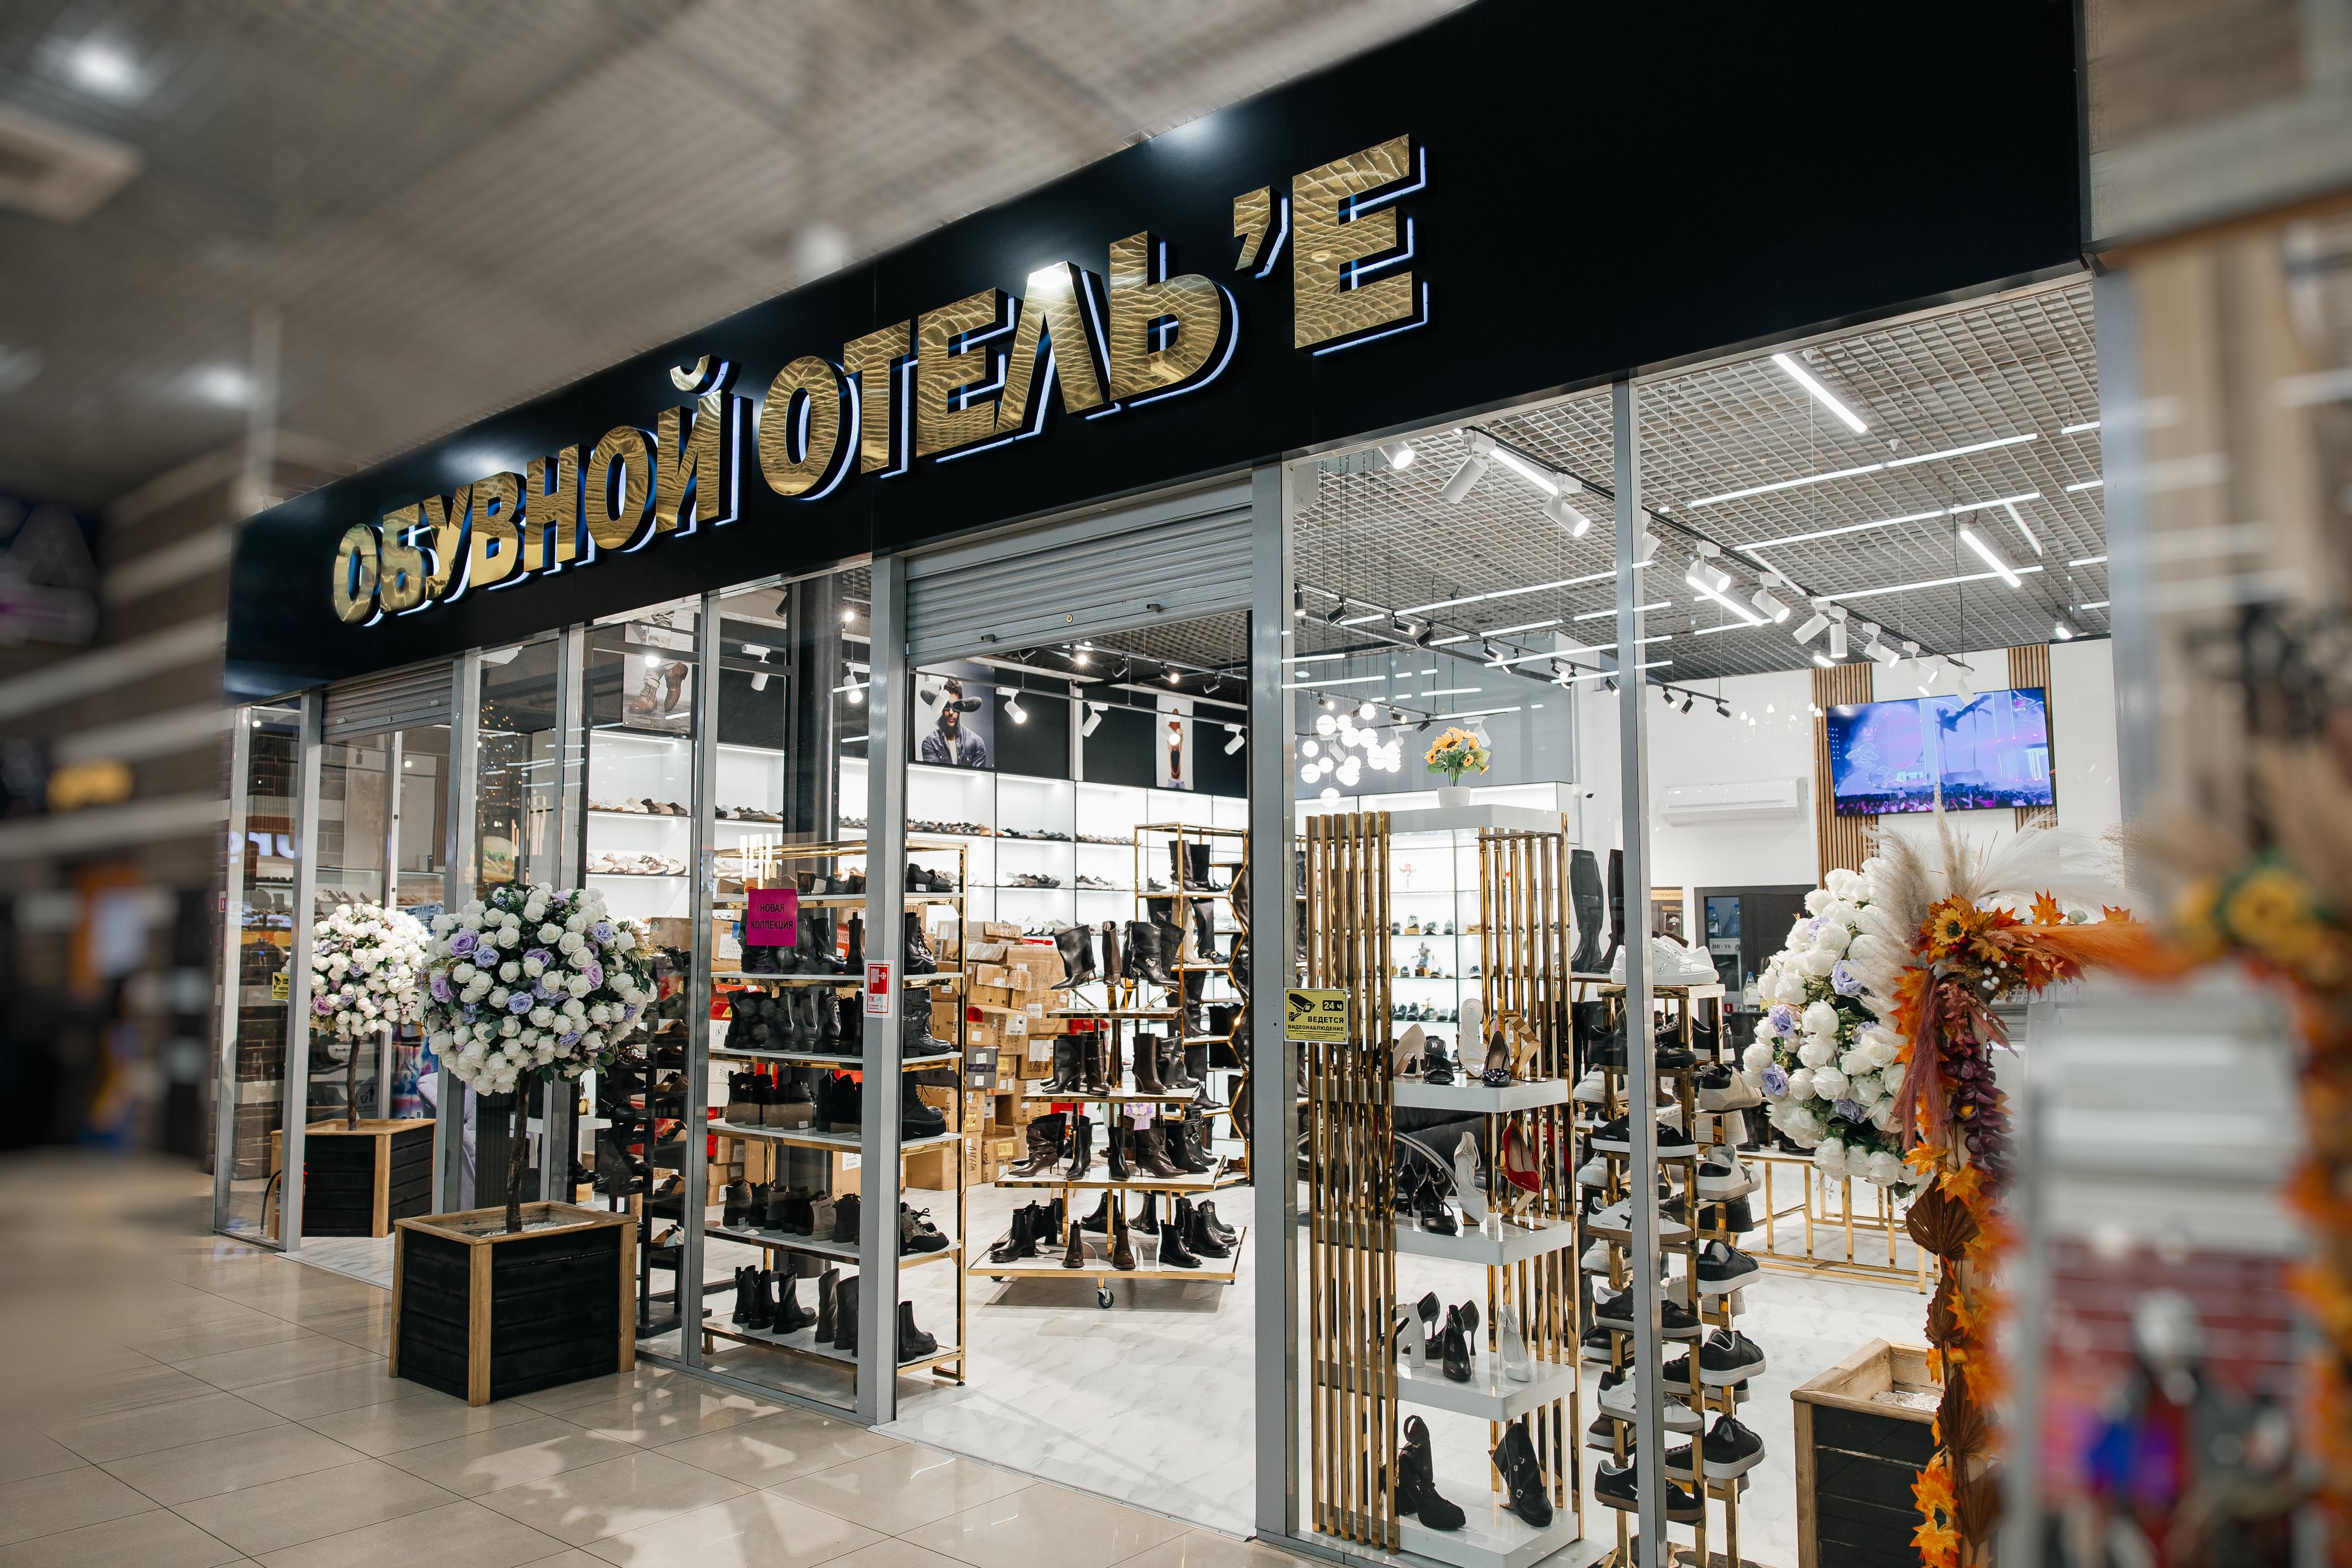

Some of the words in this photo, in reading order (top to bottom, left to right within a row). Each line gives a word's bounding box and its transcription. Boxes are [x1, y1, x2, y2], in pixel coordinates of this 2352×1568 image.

[333, 354, 729, 625] ОБУВНОЙ
[760, 902, 785, 913] НОВАЯ
[751, 920, 793, 931] КОЛЛЕКЦИЯ
